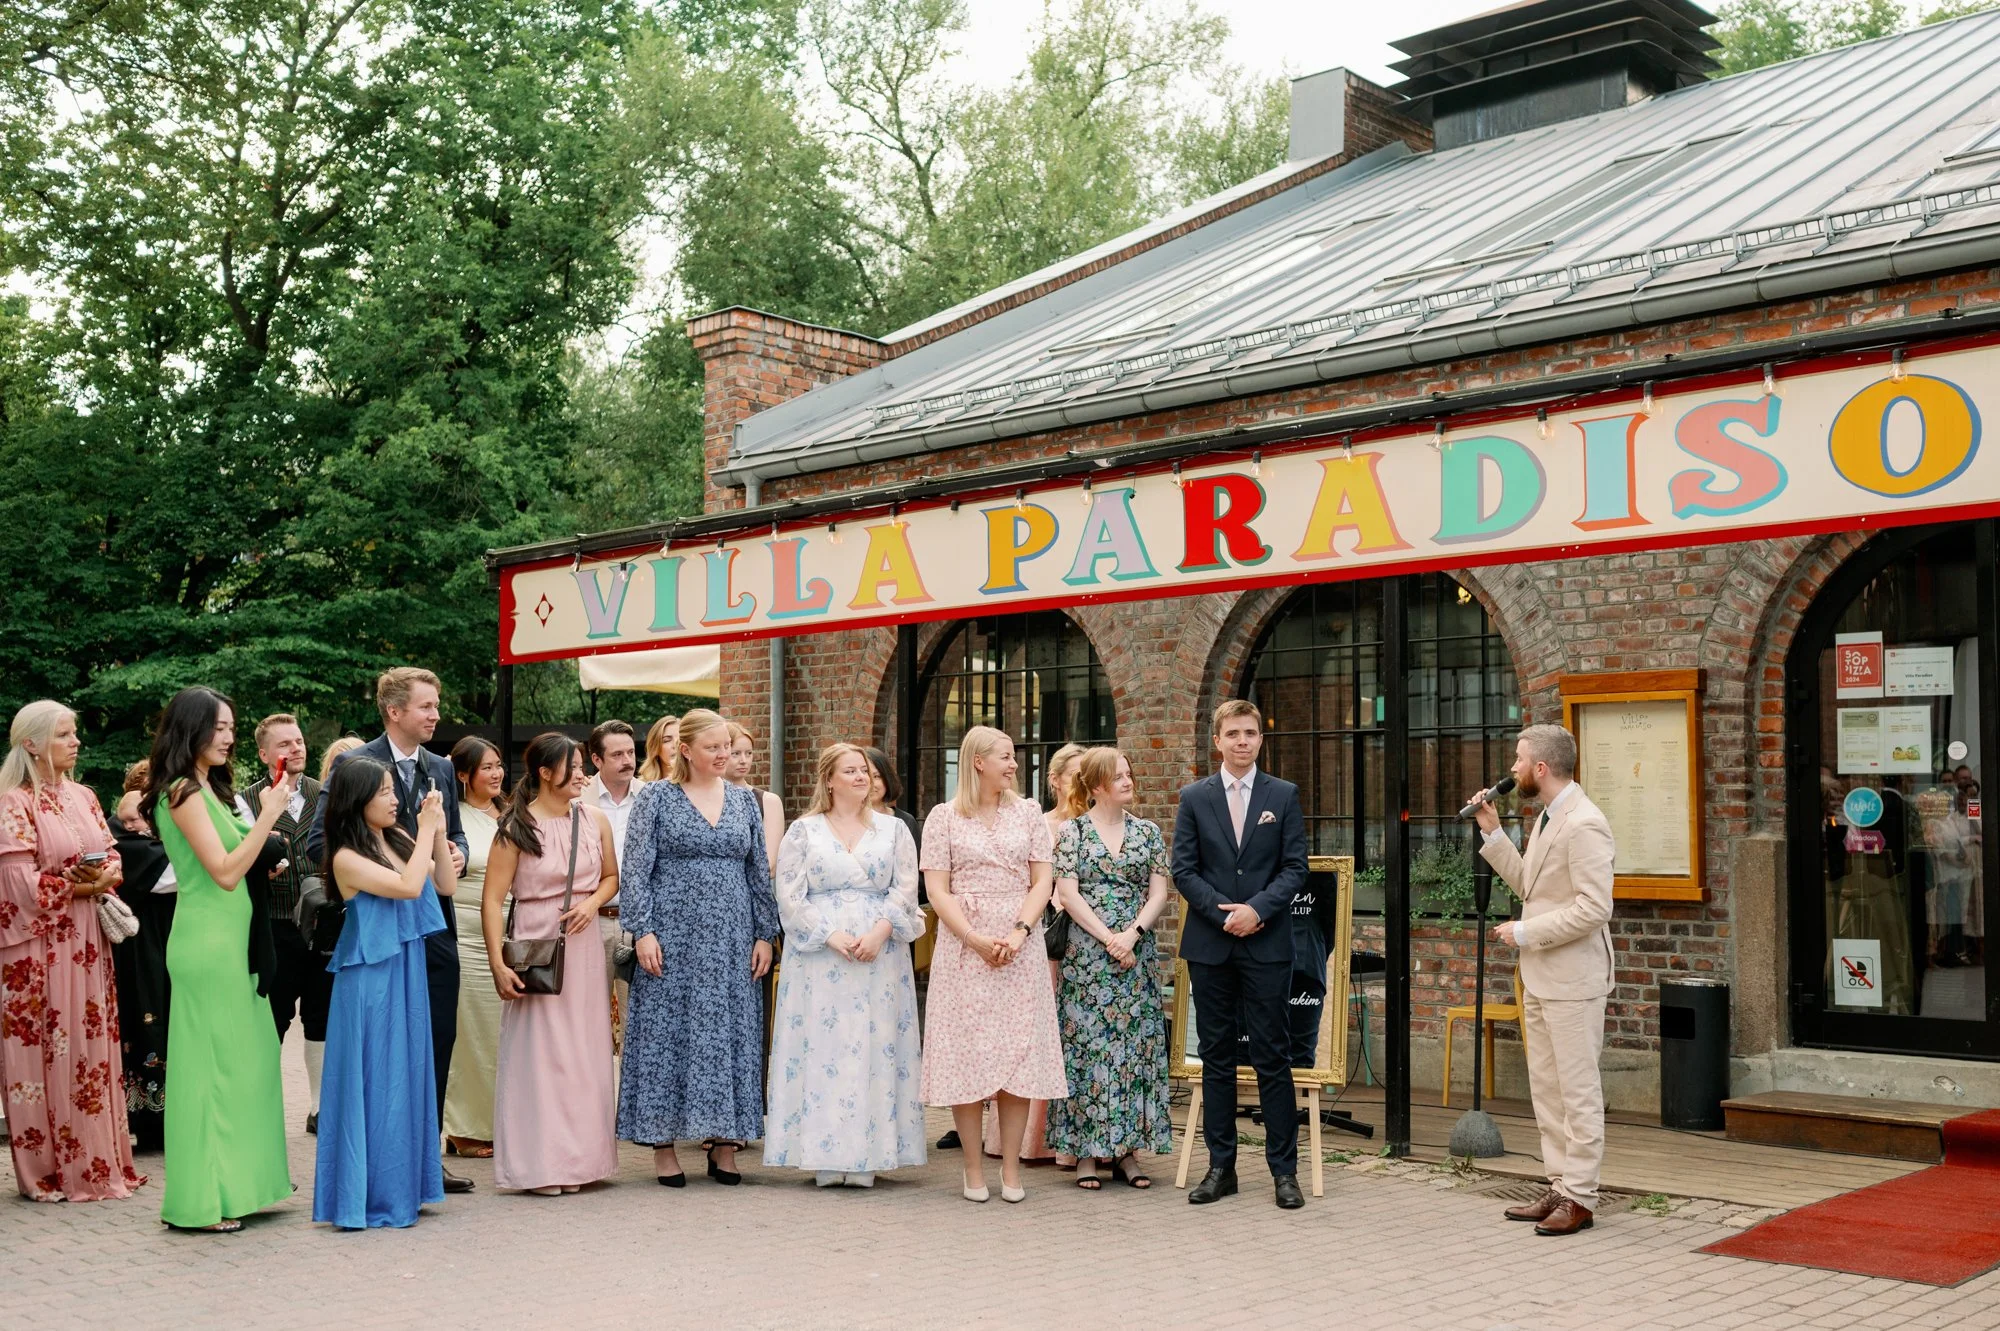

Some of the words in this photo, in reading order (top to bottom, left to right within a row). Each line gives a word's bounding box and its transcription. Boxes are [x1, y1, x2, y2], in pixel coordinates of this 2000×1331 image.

[575, 521, 934, 640] VILLA
[978, 373, 1982, 596] PARADISO
[1845, 656, 1869, 666] TOP
[1290, 892, 1316, 904] en
[1288, 991, 1321, 1006] akim
